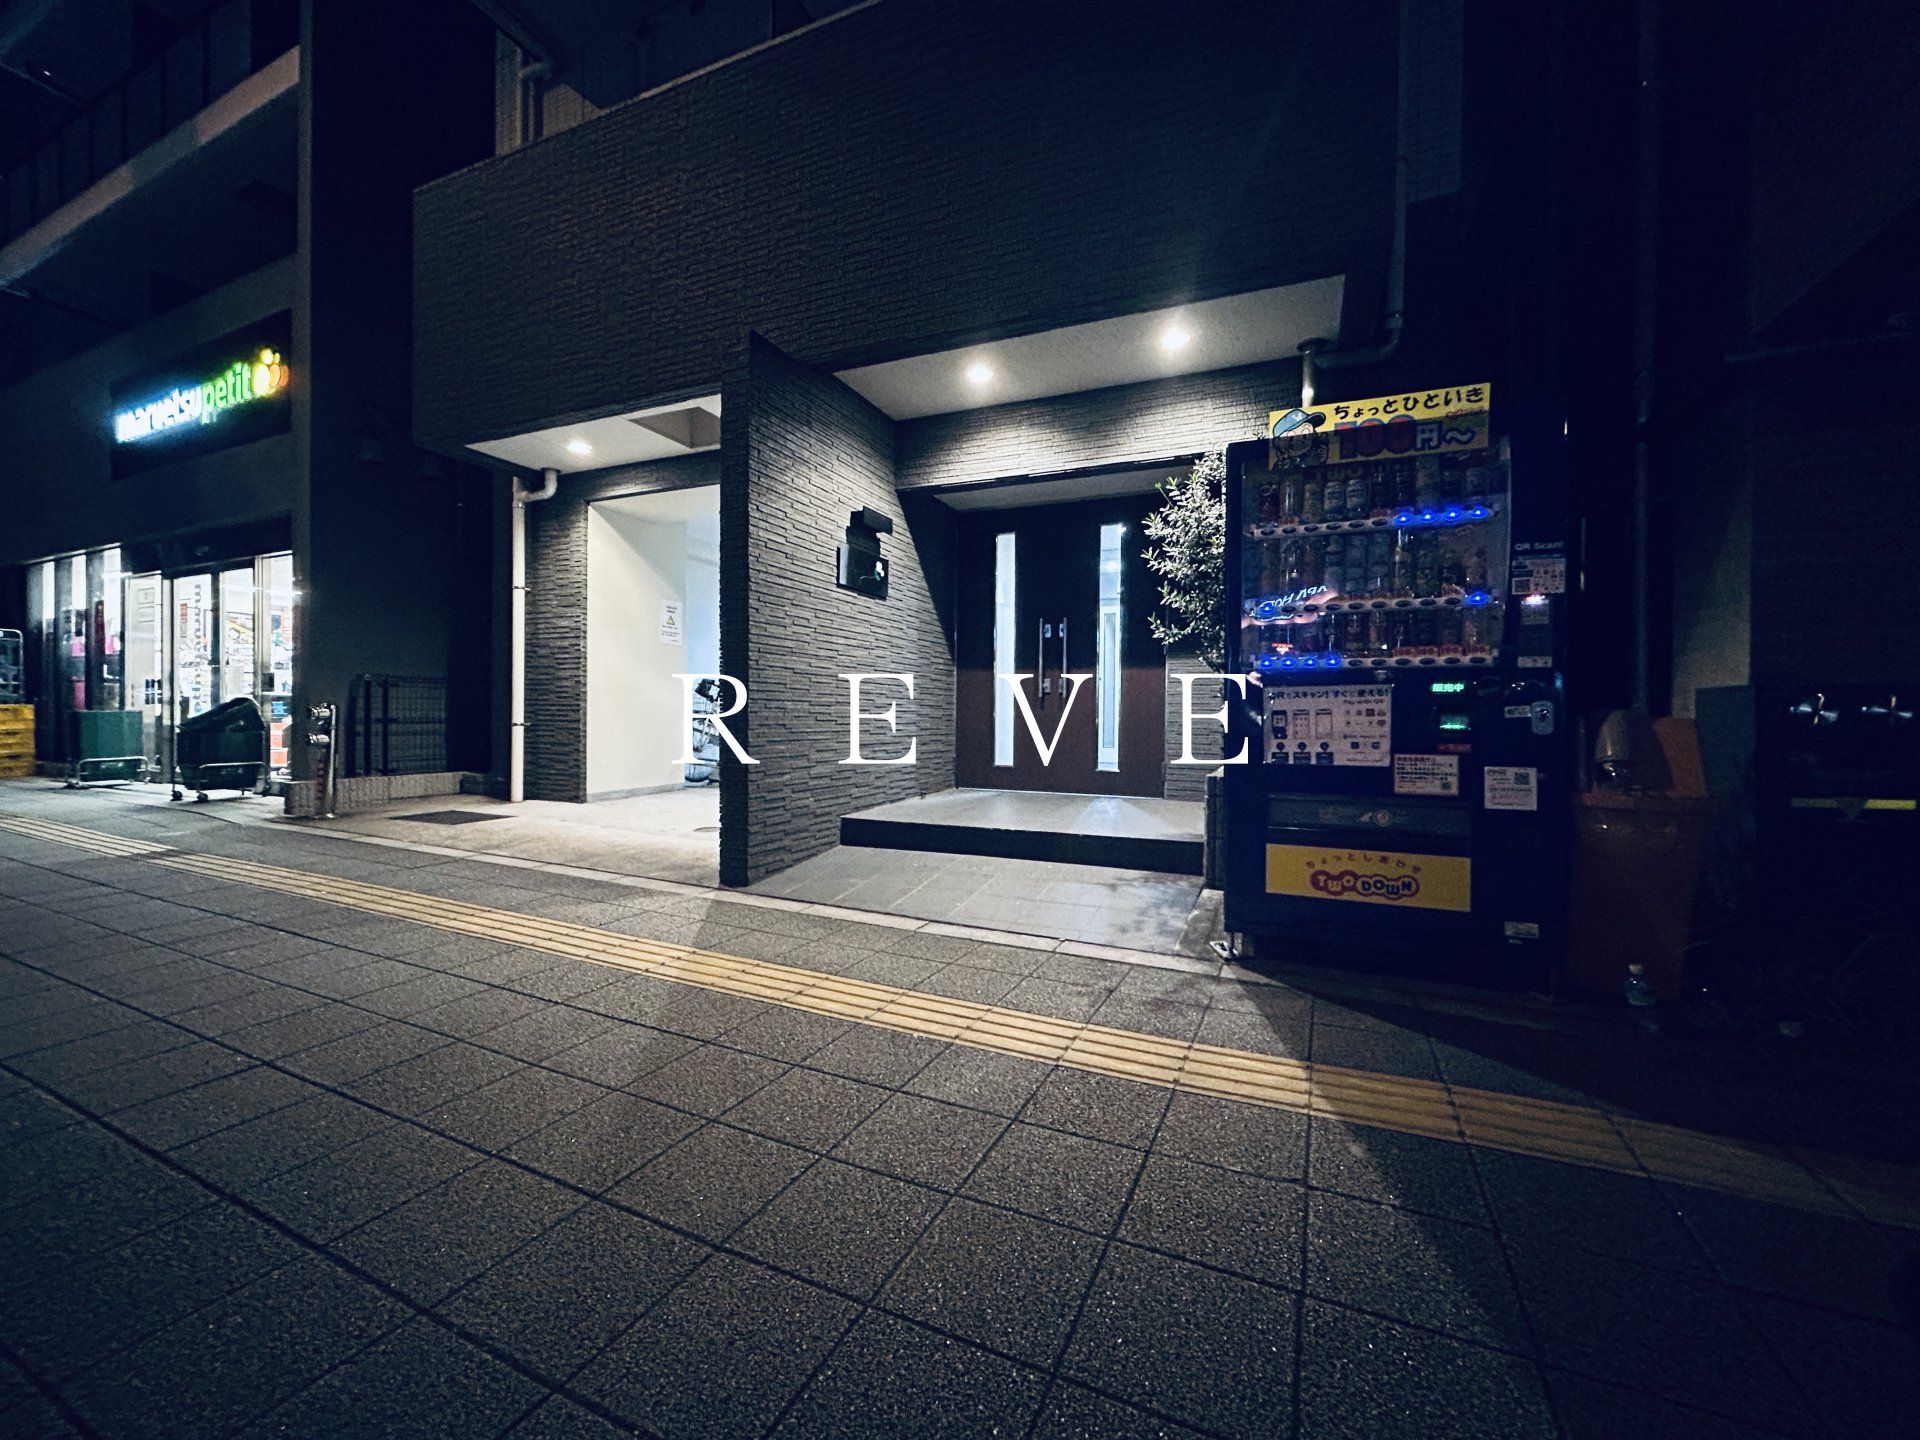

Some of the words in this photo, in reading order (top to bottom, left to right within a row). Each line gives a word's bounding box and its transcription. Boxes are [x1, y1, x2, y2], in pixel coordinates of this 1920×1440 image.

[1334, 387, 1484, 420] ちょっとひといき
